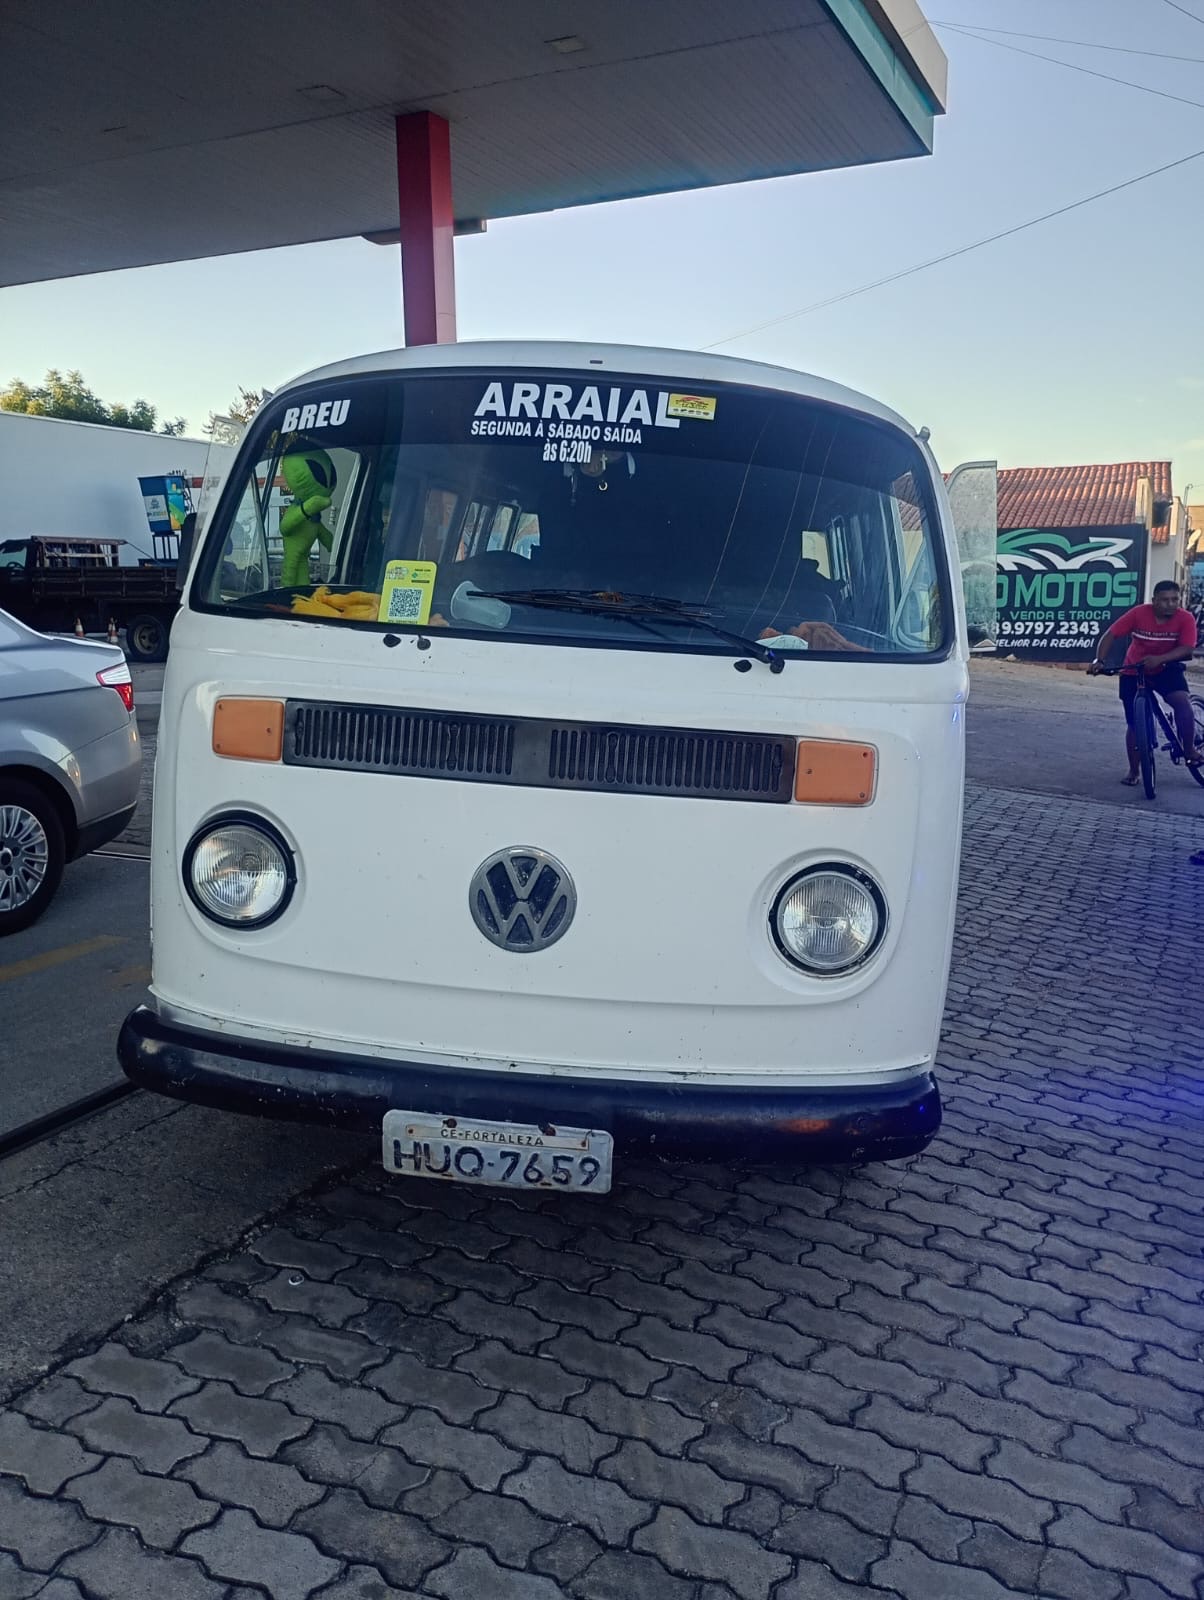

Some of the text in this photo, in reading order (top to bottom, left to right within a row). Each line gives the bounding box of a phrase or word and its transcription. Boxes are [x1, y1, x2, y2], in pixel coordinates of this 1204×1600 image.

[281, 400, 351, 434] BREU
[474, 382, 680, 429] ARRAIAL
[471, 420, 532, 437] SEGUNDA
[548, 422, 601, 441] SÁBADO
[603, 424, 642, 444] SAÍDA
[543, 438, 592, 463] às 6:20h
[1014, 572, 1138, 608] MOTOS
[1009, 610, 1055, 621] VENDA
[1057, 610, 1065, 621] E
[1069, 610, 1111, 621] TROCA
[1031, 639, 1048, 648] DA
[393, 1139, 601, 1187] HUQ-7659
